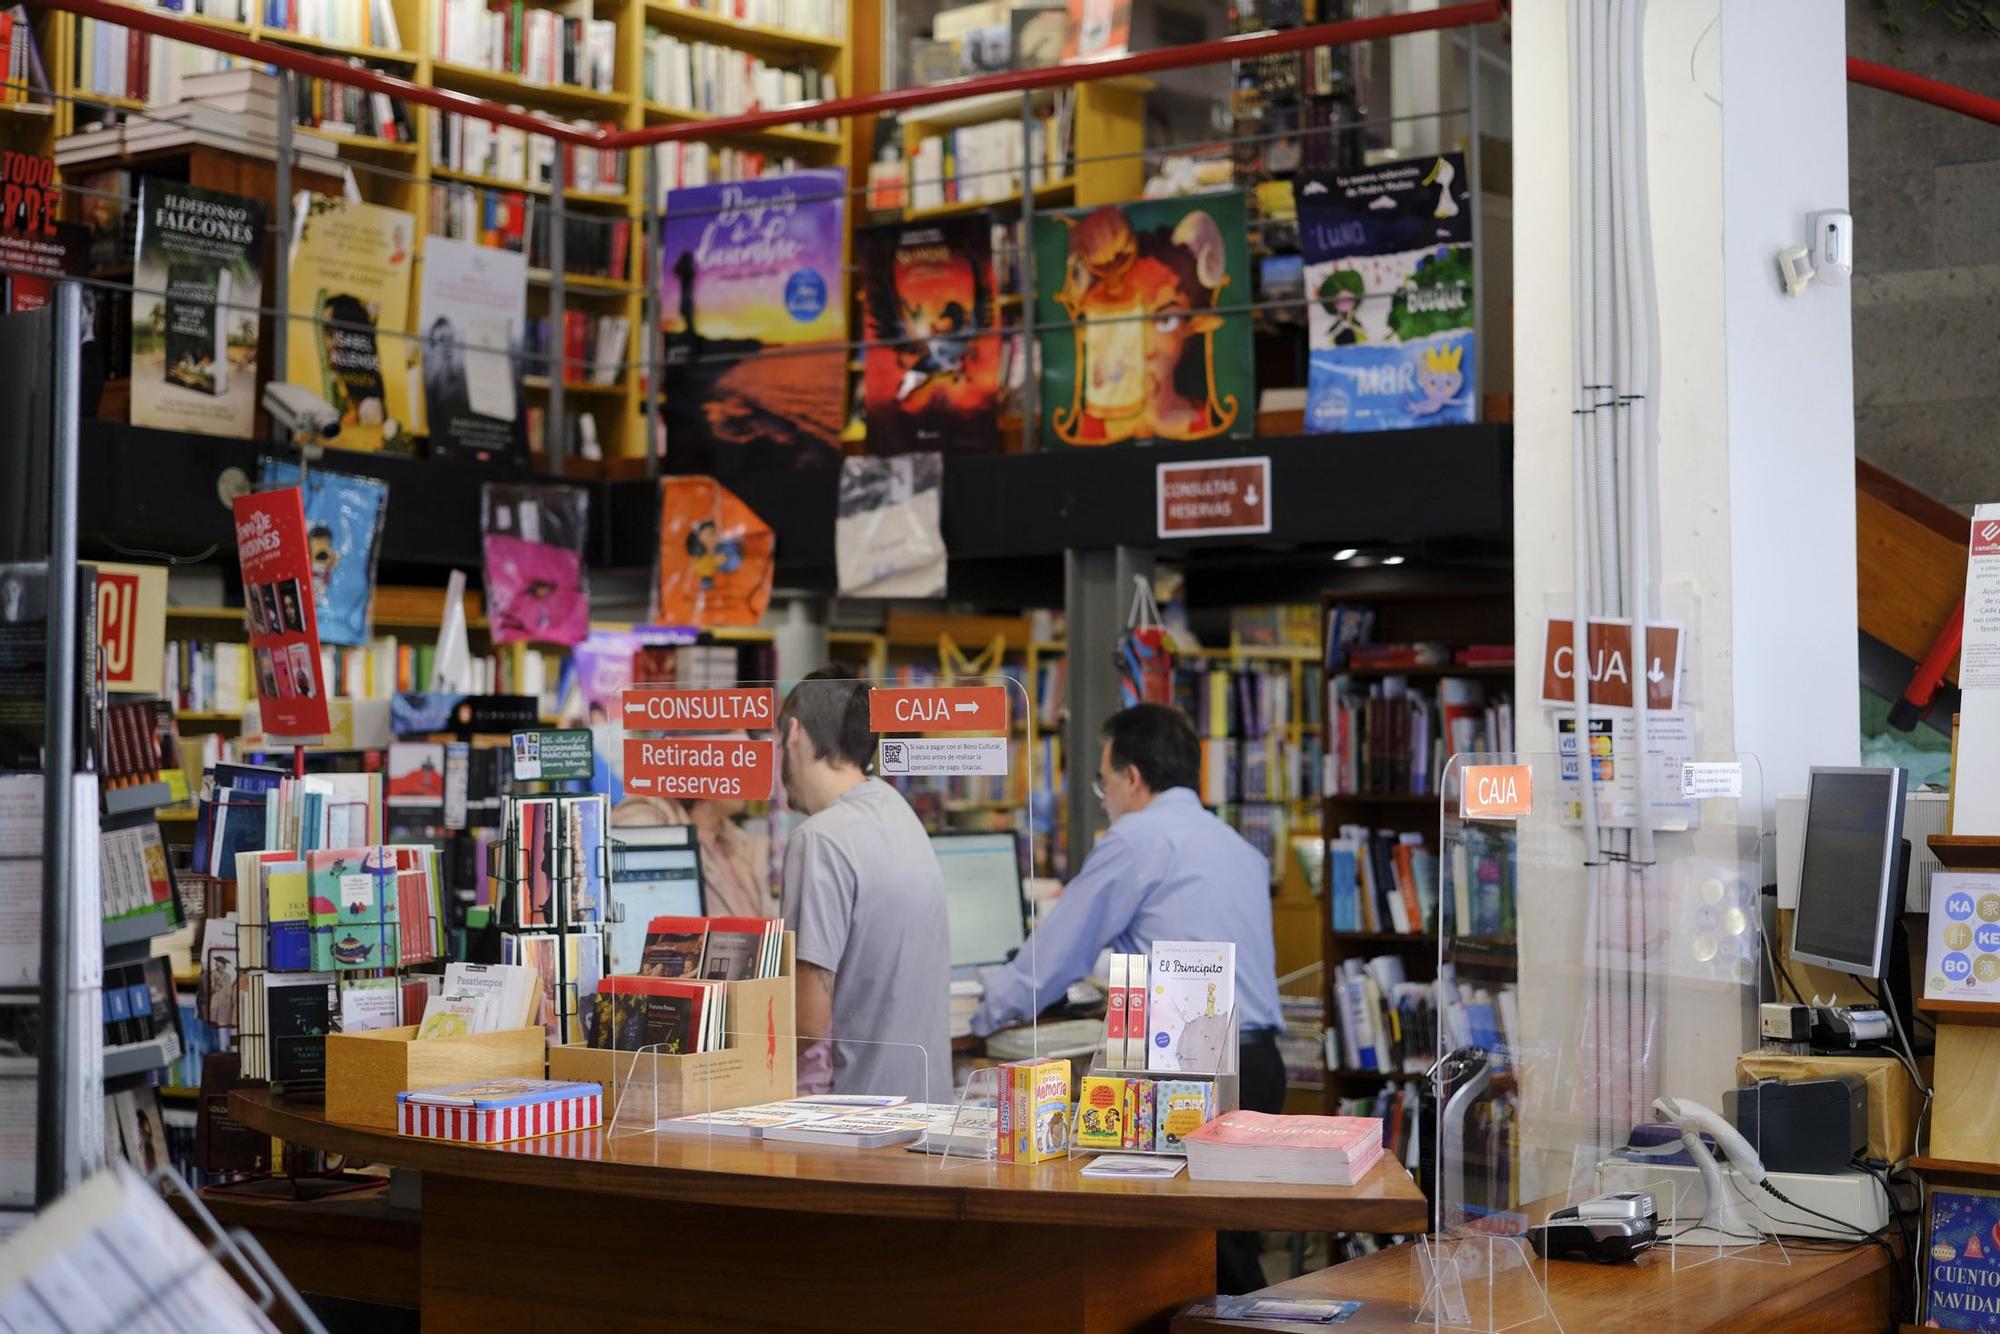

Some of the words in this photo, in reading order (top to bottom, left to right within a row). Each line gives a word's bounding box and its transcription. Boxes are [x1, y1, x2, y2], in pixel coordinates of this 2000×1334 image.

[4, 151, 54, 188] TODO
[165, 193, 247, 223] ILDEFONSO
[155, 207, 254, 245] FALCONES
[1164, 479, 1238, 498] CONSULTAS
[1169, 501, 1232, 519] RESERVAS
[647, 695, 769, 719] CONSULTAS
[895, 698, 951, 721] CAJA
[642, 743, 724, 767] Retirada
[731, 744, 757, 768] de
[910, 763, 937, 771] operación
[657, 775, 741, 795] reservas
[1478, 776, 1518, 804] CAJA
[1949, 900, 1971, 913] KA
[1978, 931, 2000, 945] KE
[1159, 960, 1170, 973] El
[1173, 960, 1223, 976] Principito
[1944, 960, 1968, 973] BO
[457, 976, 503, 989] Pasatiempos
[1034, 1080, 1067, 1099] Memoria
[1001, 1101, 1009, 1133] MENTE
[1247, 1126, 1348, 1136] INVIERNO
[1934, 1265, 2000, 1287] CUENTO
